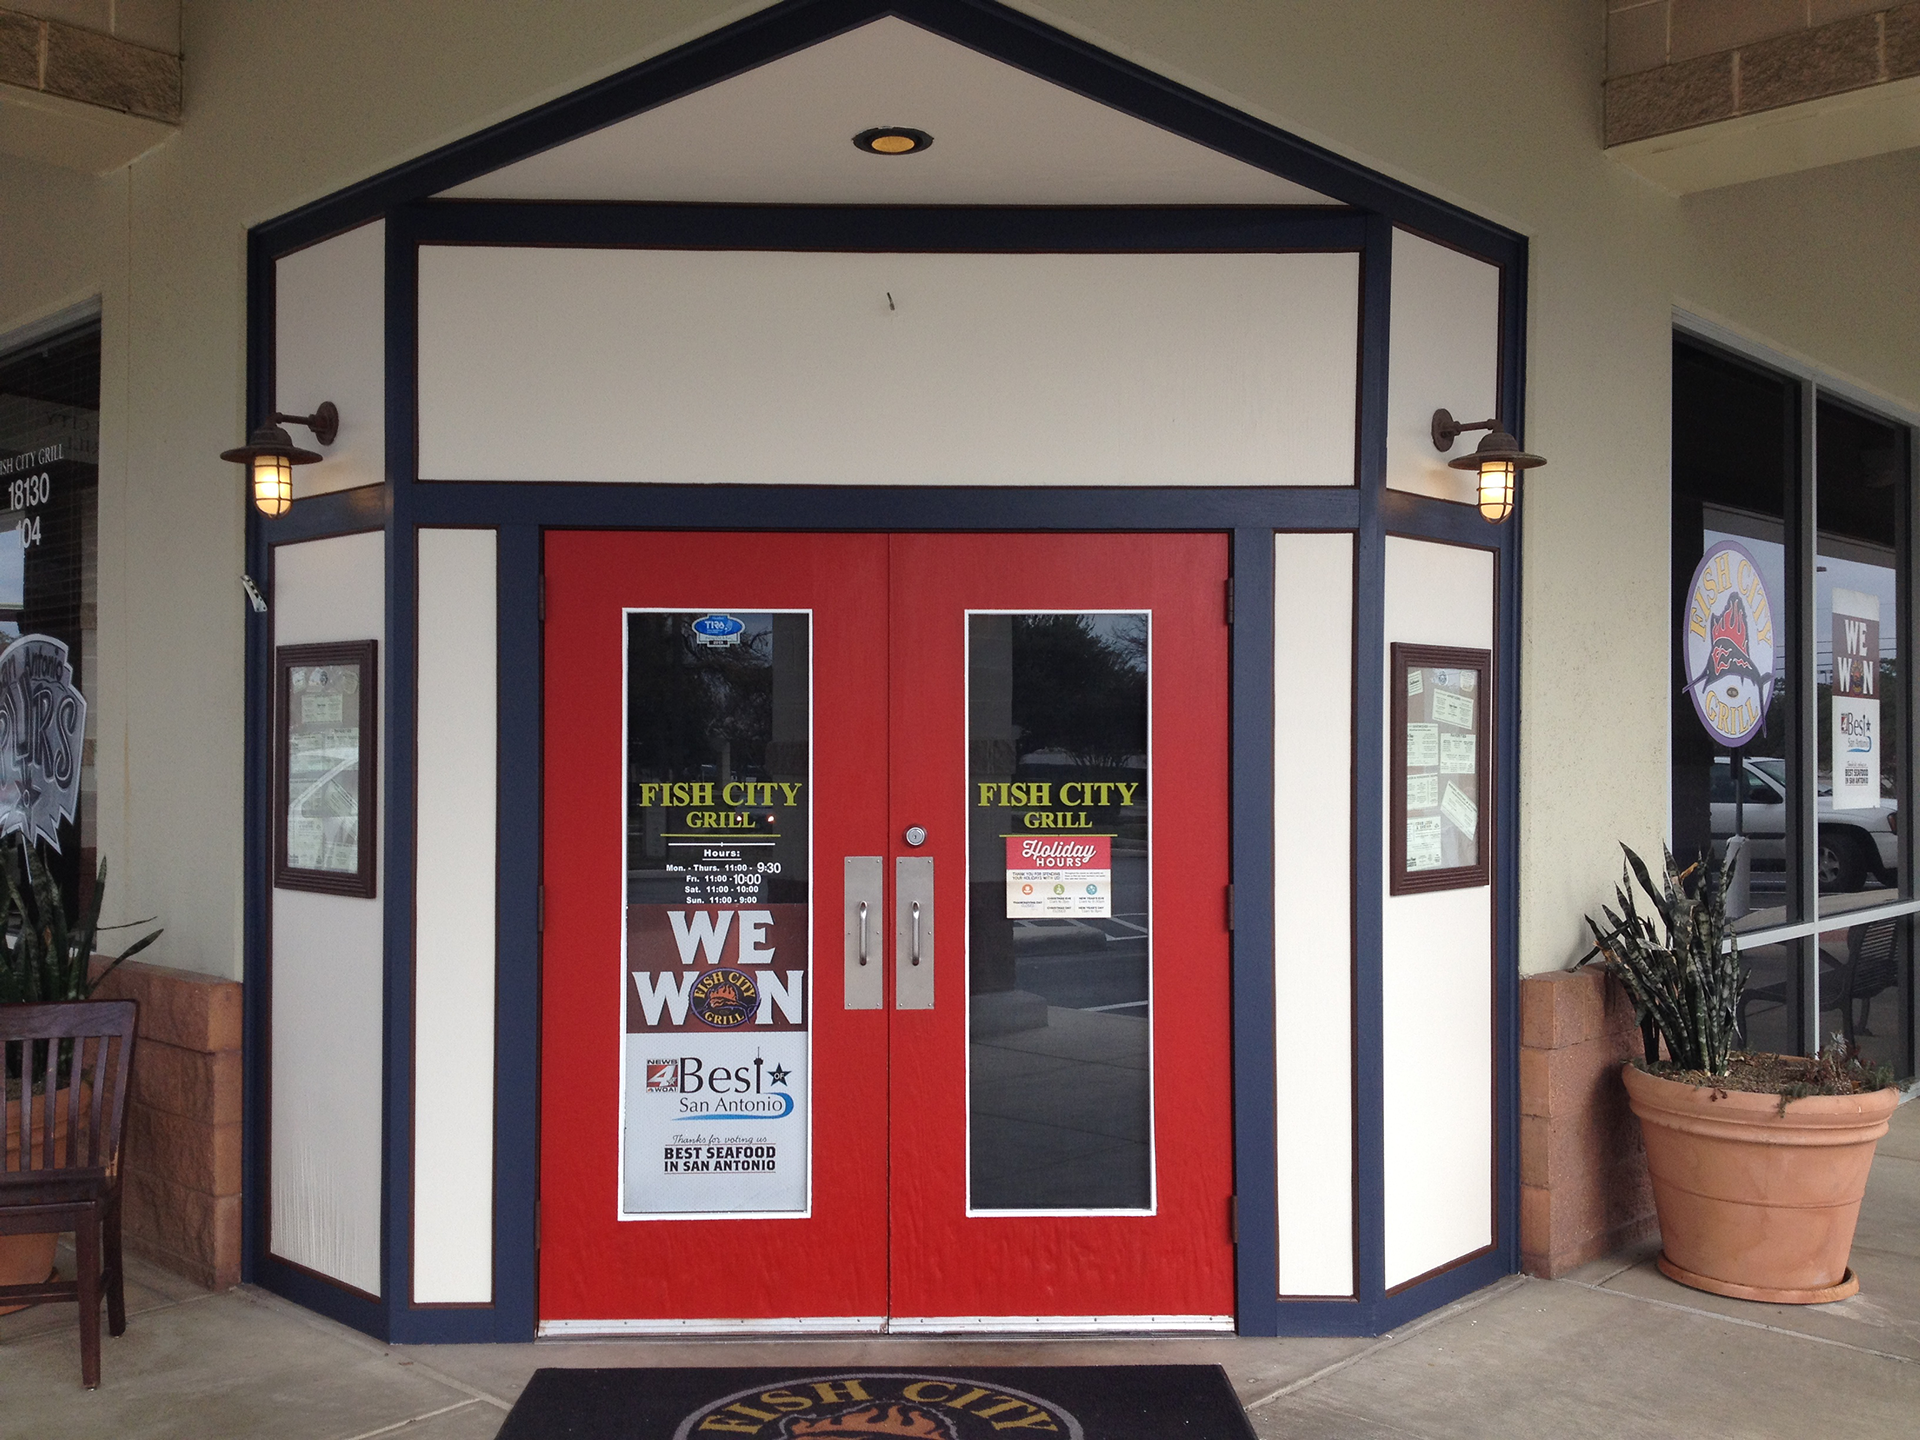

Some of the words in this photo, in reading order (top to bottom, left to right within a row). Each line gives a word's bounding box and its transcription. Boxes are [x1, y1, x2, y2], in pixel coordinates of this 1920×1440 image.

[0, 457, 14, 475] ISH
[15, 451, 36, 471] CITY
[38, 443, 64, 465] GRILL
[8, 472, 50, 511] 18130
[16, 516, 41, 548] 104
[1690, 552, 1732, 643] FISH
[1737, 558, 1773, 649] CITY
[1844, 619, 1868, 657] WE
[1, 654, 17, 687] an
[24, 646, 64, 682] Antonio
[1705, 690, 1760, 735] GRILL
[0, 672, 77, 790] PURS
[639, 782, 715, 807] FISH
[723, 782, 802, 806] CITY
[977, 782, 1052, 807] FISH
[1059, 782, 1139, 806] CITY
[686, 811, 756, 828] GRILL
[1024, 811, 1093, 828] GRILL
[703, 848, 741, 858] Hours:
[1021, 839, 1096, 864] Holiday
[1036, 858, 1082, 867] HOURS
[666, 864, 686, 872] Mon.
[693, 864, 720, 872] Thurs.
[725, 864, 748, 872] 11:00
[757, 862, 782, 874] 9:30
[686, 875, 700, 883] Fri.
[704, 875, 727, 883] 11:00
[733, 874, 762, 885] 10:00
[685, 885, 701, 893] Sat.
[686, 896, 705, 904] Sun.
[709, 896, 732, 904] 11:00
[739, 896, 758, 904] 9:00
[666, 910, 776, 965] WE
[694, 971, 724, 999] FISH
[728, 971, 756, 998] CITY
[704, 1011, 745, 1025] GRILL
[680, 1047, 764, 1094] Best
[774, 1072, 785, 1080] OF
[680, 1097, 709, 1113] San
[715, 1097, 783, 1112] Antonio
[664, 1147, 702, 1160] BEST
[706, 1146, 776, 1159] SEAFOOD
[672, 1134, 706, 1145] Thanks
[708, 1134, 720, 1147] for
[724, 1135, 754, 1146] voting
[664, 1161, 679, 1172] IN
[683, 1160, 710, 1172] SAN
[714, 1160, 776, 1171] ANTONIO
[699, 1380, 873, 1435] FISH
[903, 1381, 1059, 1433] CITY
